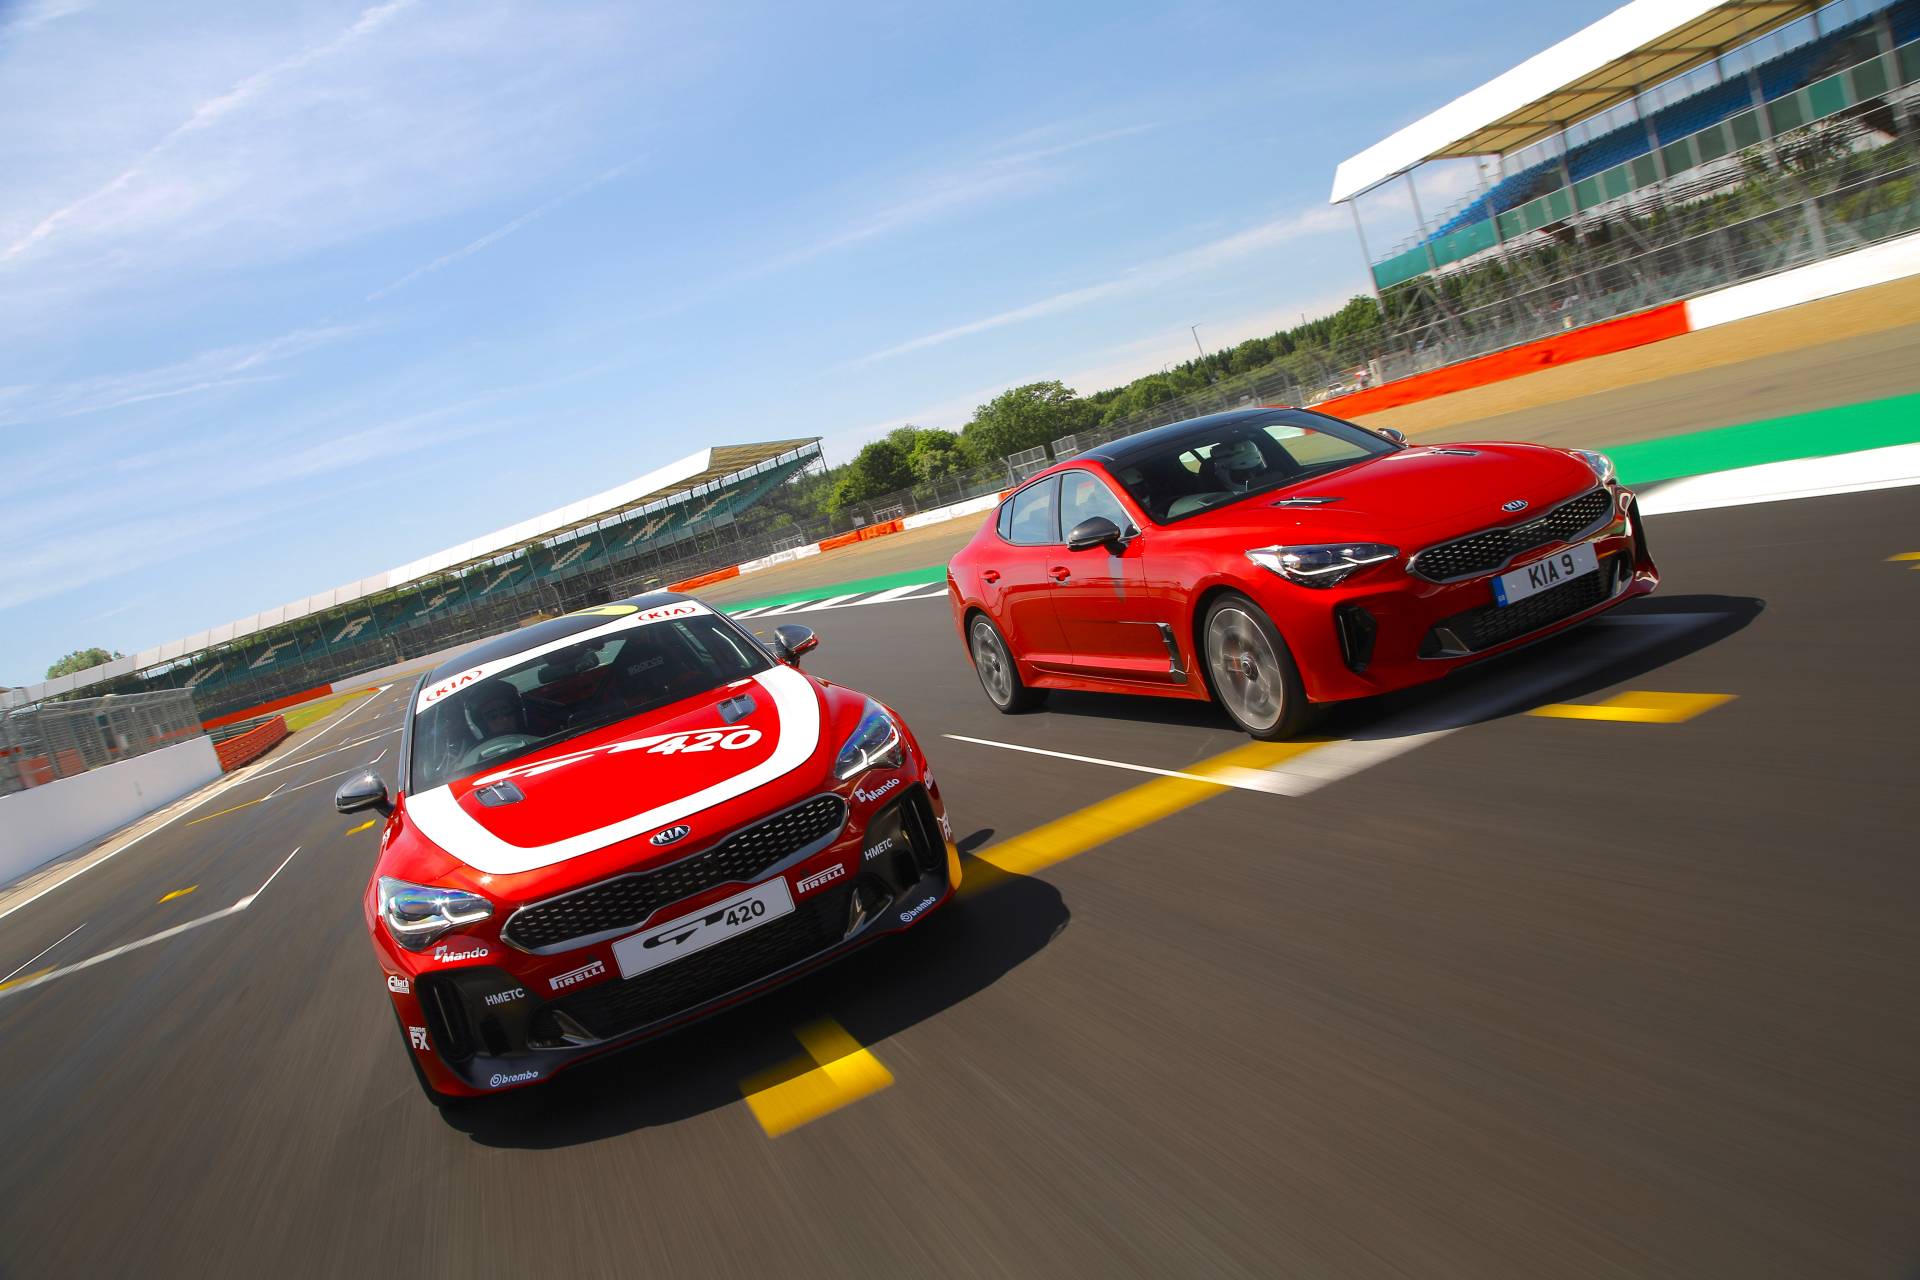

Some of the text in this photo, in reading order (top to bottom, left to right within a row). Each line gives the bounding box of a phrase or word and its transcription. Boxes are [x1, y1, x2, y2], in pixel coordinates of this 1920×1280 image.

[1504, 500, 1527, 512] KIA
[1528, 560, 1560, 588] KIA
[1561, 554, 1575, 575] 9
[648, 607, 693, 619] KIA
[435, 674, 473, 698] KIA
[866, 778, 900, 802] Mando
[655, 825, 687, 843] KIA
[864, 838, 893, 860] HMETC
[797, 863, 845, 893] PIRELLI
[909, 896, 936, 916] brembo
[442, 947, 488, 963] Mando
[549, 960, 606, 990] PIRELLI
[485, 988, 526, 1006] HMETC
[502, 1071, 539, 1084] brembo
